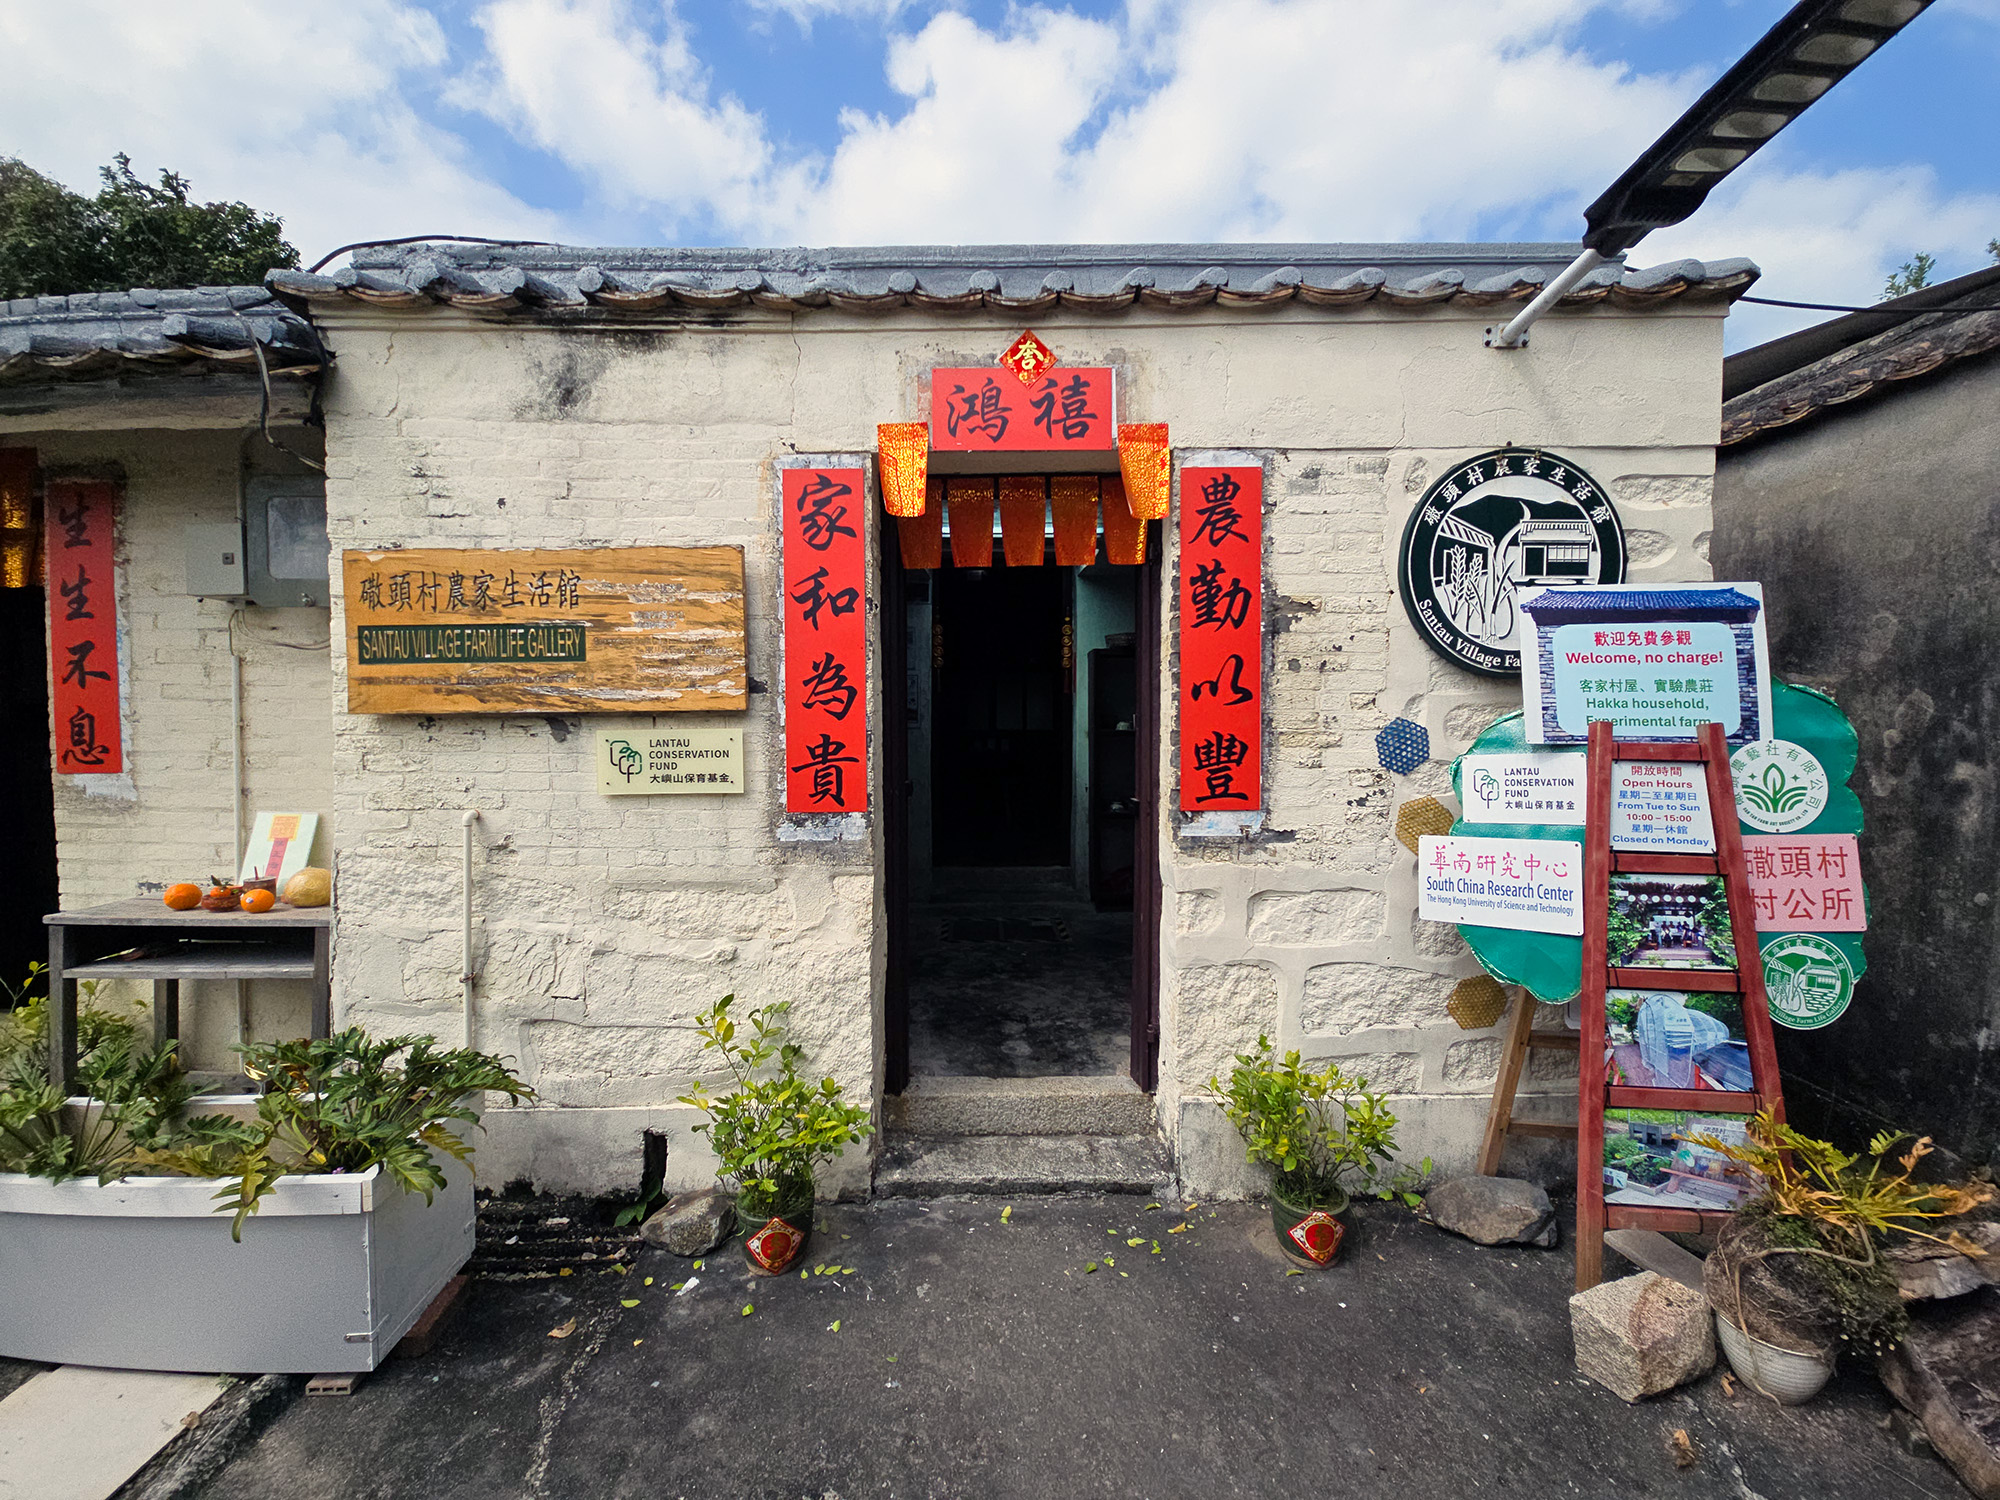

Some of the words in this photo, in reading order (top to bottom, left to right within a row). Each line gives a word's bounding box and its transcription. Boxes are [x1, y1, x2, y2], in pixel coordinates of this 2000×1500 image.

[945, 374, 1099, 443] 鴻禧
[58, 493, 111, 766] 生生不息
[1419, 599, 1454, 645] Santau
[1455, 637, 1501, 668] Village
[1504, 654, 1521, 667] Fa
[362, 629, 410, 659] SANTAU
[411, 629, 461, 659] VILLAGE
[464, 629, 498, 658] FARM
[500, 628, 525, 658] LIFE
[527, 628, 582, 658] GALLERY
[789, 473, 860, 808] 家和為貴
[1187, 472, 1253, 804] 農勤以豐
[1594, 630, 1692, 647] 歡迎免費參觀
[1566, 652, 1641, 666] Welcome,
[1645, 653, 1664, 664] no
[1667, 651, 1724, 666] charge!
[1579, 679, 1714, 694] 客家村屋、實驗農莊
[1586, 698, 1629, 709] Hakka
[1632, 698, 1709, 711] household,
[649, 739, 690, 748] LANTAU
[649, 750, 730, 759] CONSERVATION
[649, 762, 678, 771] FUND
[1504, 767, 1540, 776] LANTAU
[1631, 765, 1683, 777] 開放時間
[649, 773, 730, 784] 大嶼山保育基金
[1504, 778, 1575, 787] CONSERVATION
[1622, 779, 1653, 788] Open
[1656, 780, 1693, 788] Hours
[1504, 790, 1529, 798] FUND
[1618, 790, 1697, 801] 星期二至星期日
[1504, 801, 1575, 810] 大嶼山保育基金
[1617, 802, 1644, 810] From
[1645, 803, 1664, 811] Tue
[1666, 803, 1677, 811] to
[1679, 804, 1701, 812] Sun
[1626, 813, 1654, 821] 10:00
[1663, 815, 1692, 823] 15:00
[1631, 824, 1688, 835] 星期一休館
[1612, 835, 1649, 844] Closed
[1651, 836, 1664, 844] on
[1666, 837, 1709, 847] Monday
[1429, 844, 1568, 881] 華南研究中心
[1426, 876, 1454, 893] South
[1457, 878, 1485, 895] China
[1487, 880, 1534, 899] Research
[1537, 884, 1574, 902] Center
[1427, 893, 1436, 902] The
[1437, 895, 1451, 906] Hong
[1452, 896, 1467, 907] Kong
[1467, 897, 1496, 910] University
[1496, 899, 1503, 909] of
[1503, 900, 1525, 911] Science
[1526, 902, 1538, 912] and
[1539, 903, 1574, 917] Technology
[1750, 888, 1853, 920] 村公所
